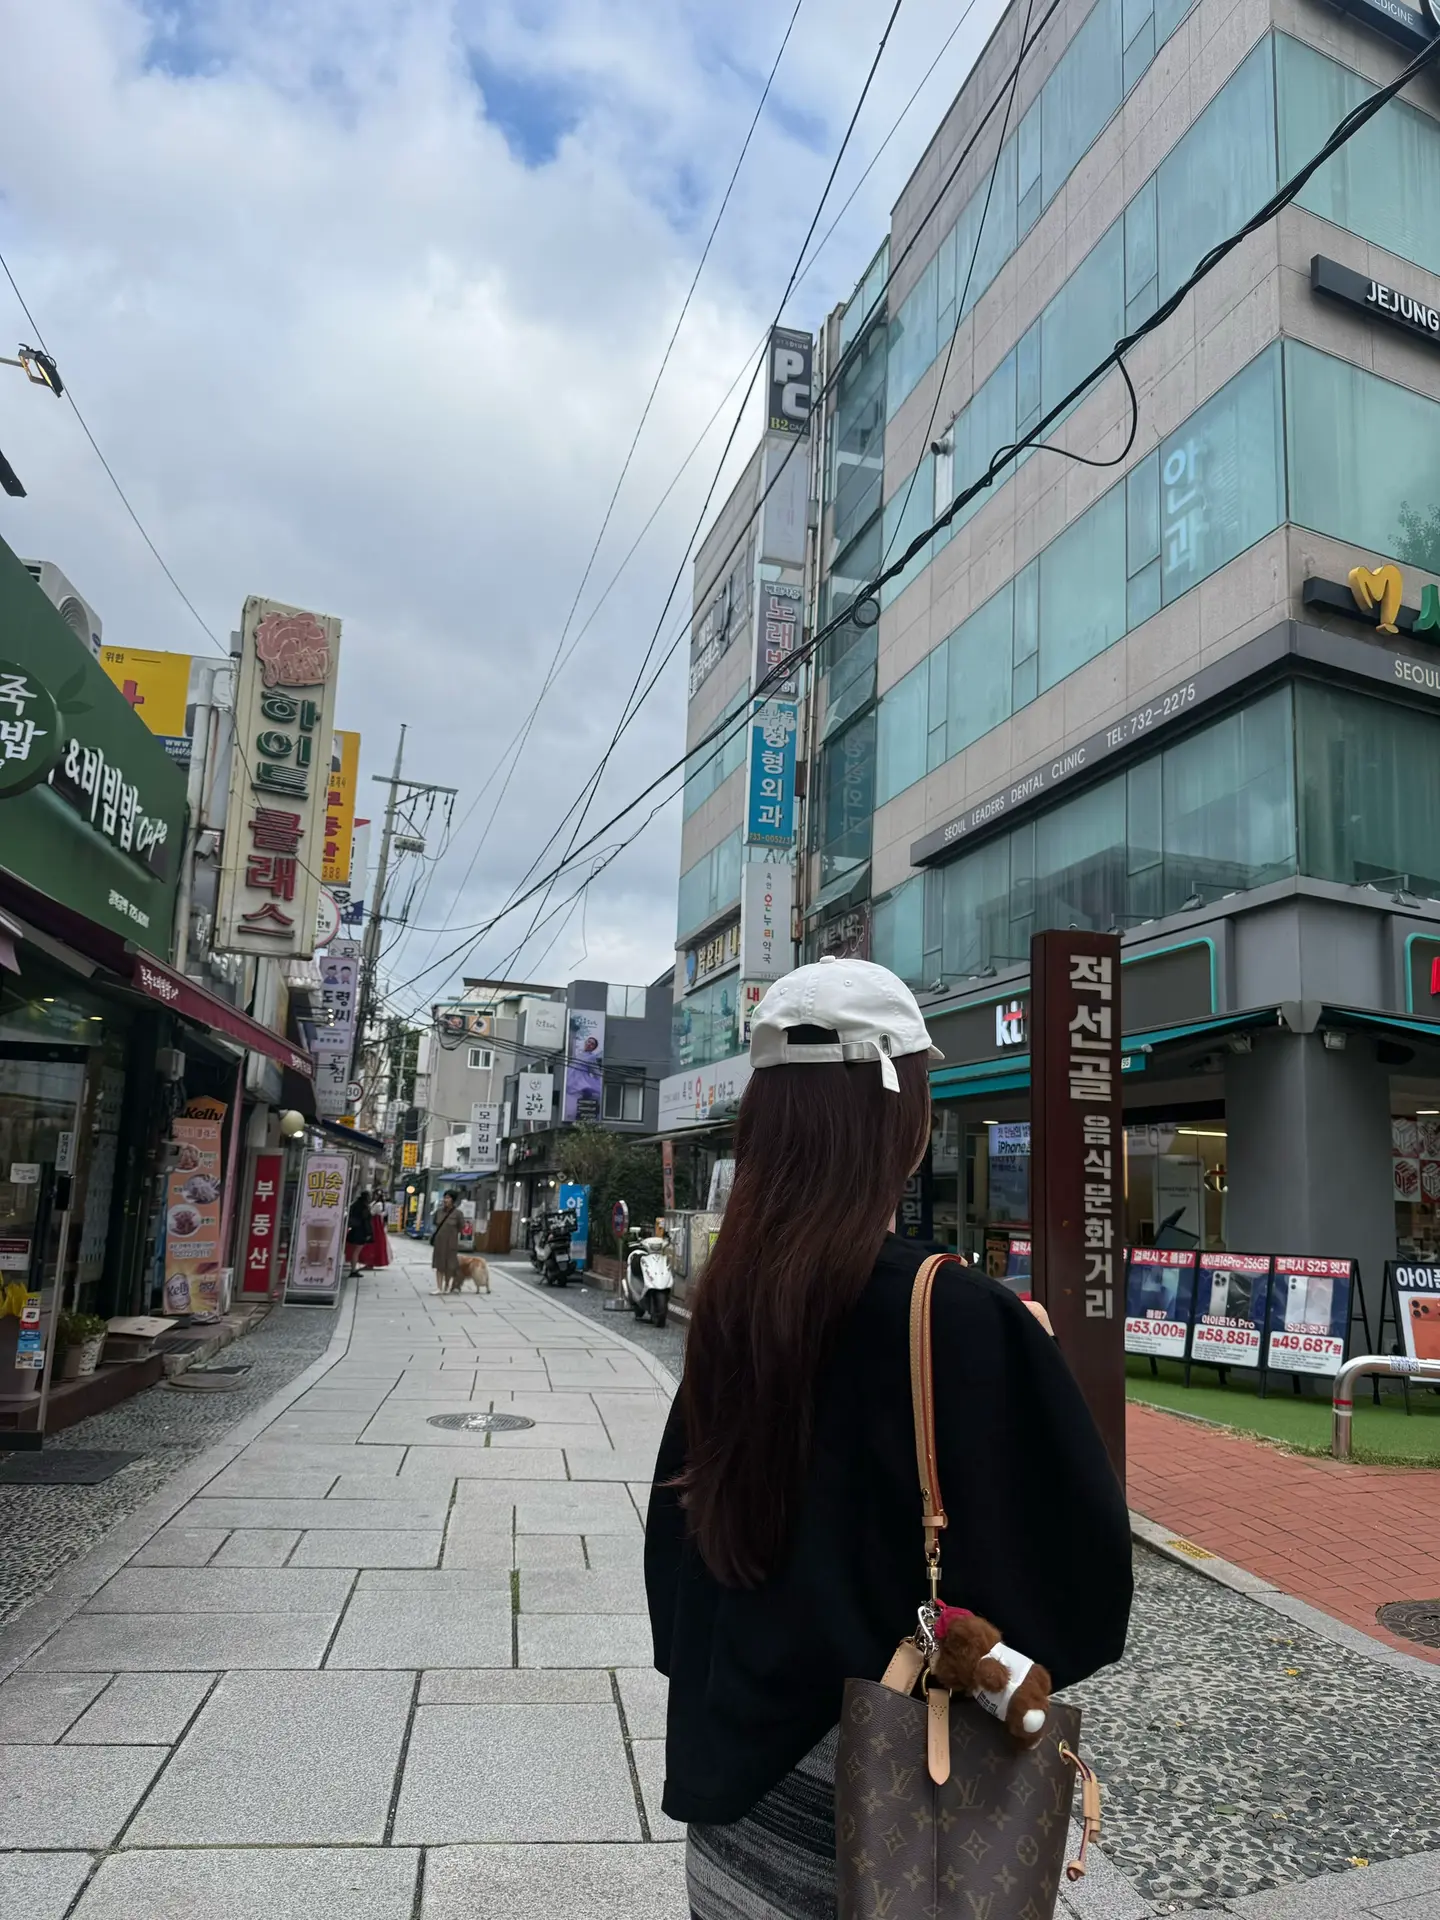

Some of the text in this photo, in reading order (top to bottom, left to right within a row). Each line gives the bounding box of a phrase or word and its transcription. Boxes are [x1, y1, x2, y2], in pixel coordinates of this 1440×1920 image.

[770, 416, 789, 431] B2
[944, 822, 967, 841] SEOUL
[972, 796, 1005, 826] LEADERS
[1011, 773, 1045, 803] DENTAL
[1051, 748, 1086, 779] CLINIC
[1130, 682, 1197, 736] 732-2275
[757, 722, 790, 829] 정형외과
[995, 1000, 1025, 1047] kt
[1068, 954, 1113, 1102] 적선골
[186, 1107, 224, 1121] Kelly
[307, 1190, 340, 1208] 가루
[249, 1179, 275, 1270] 부동산
[1082, 1114, 1115, 1320] 음식문화거리
[1160, 1253, 1168, 1264] Z
[1306, 1260, 1328, 1273] S25
[1237, 1318, 1255, 1330] Pro
[1286, 1322, 1307, 1332] S25
